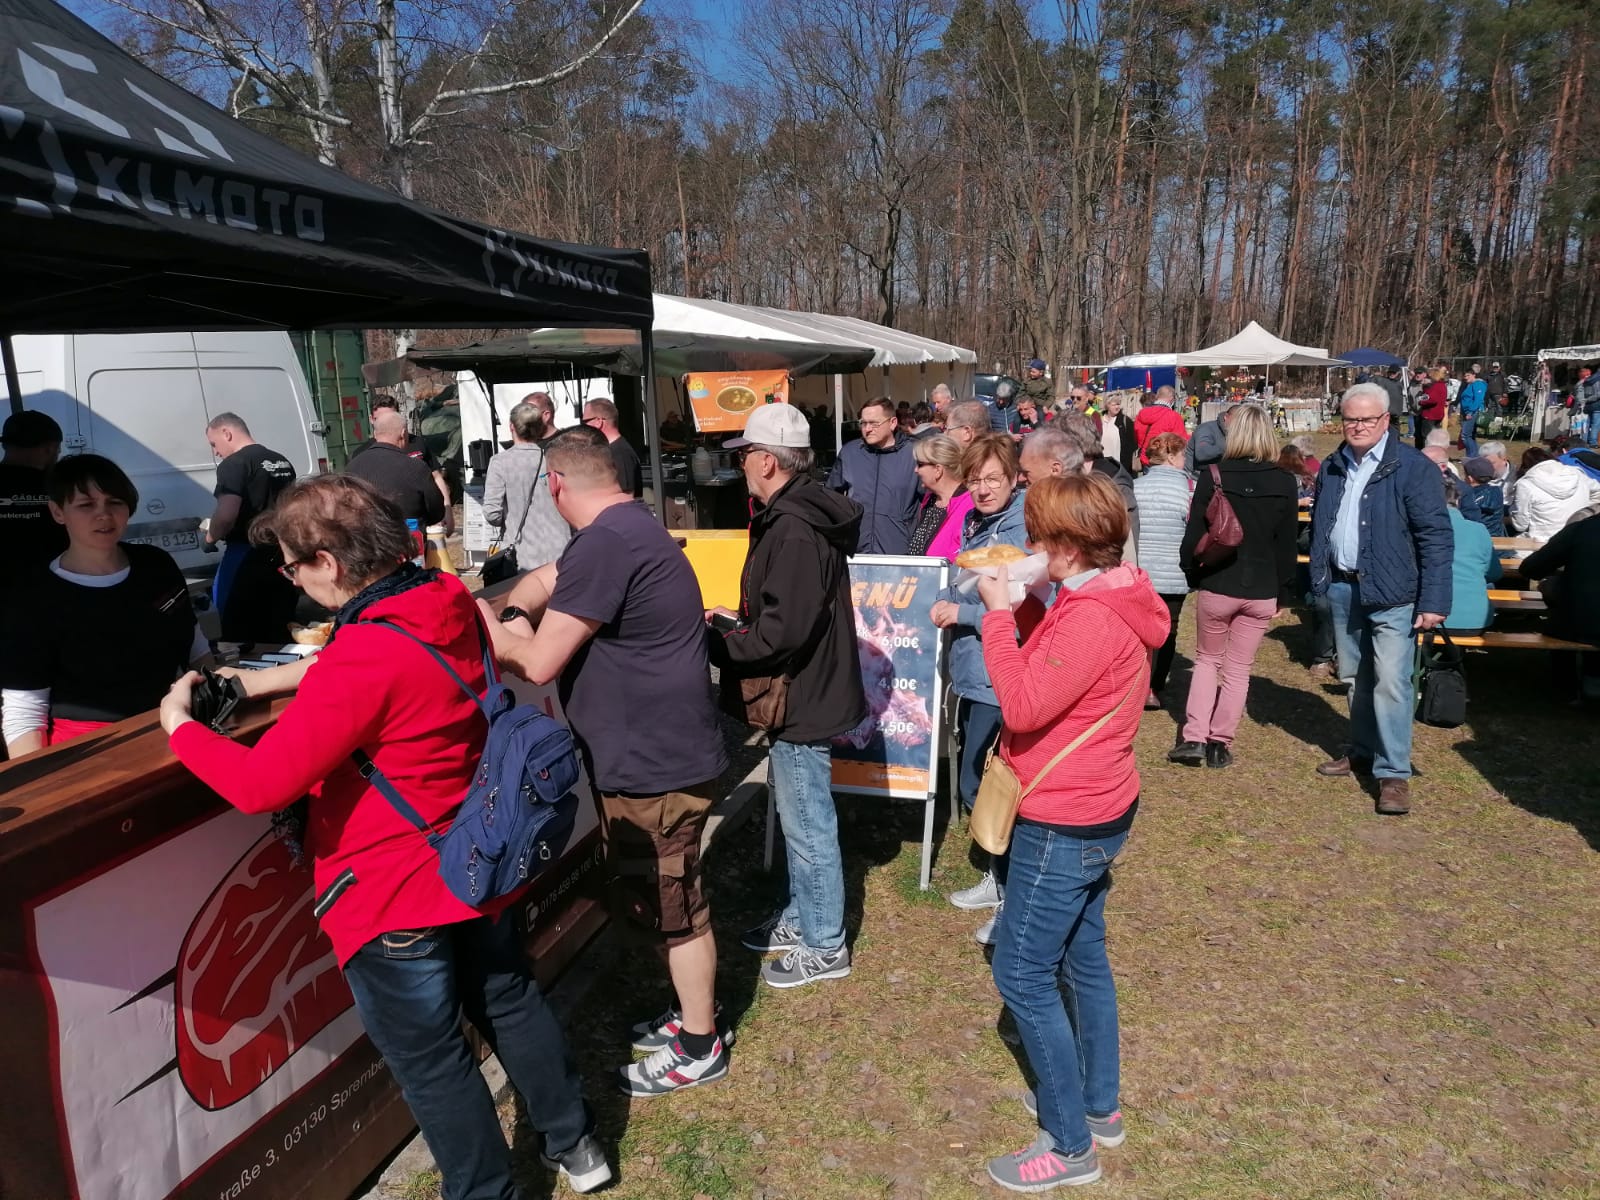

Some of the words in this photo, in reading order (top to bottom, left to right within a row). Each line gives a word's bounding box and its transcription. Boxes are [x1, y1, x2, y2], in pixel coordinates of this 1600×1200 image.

[85, 150, 326, 242] XLMOTO
[525, 251, 619, 295] XLMOTO
[173, 532, 196, 546] 123
[881, 635, 919, 649] 6,00€
[878, 677, 917, 691] 4,00€
[876, 720, 914, 736] 2,50€
[265, 1149, 280, 1167] 3,
[284, 1104, 327, 1151] 03130
[330, 1056, 386, 1111] Sprembe
